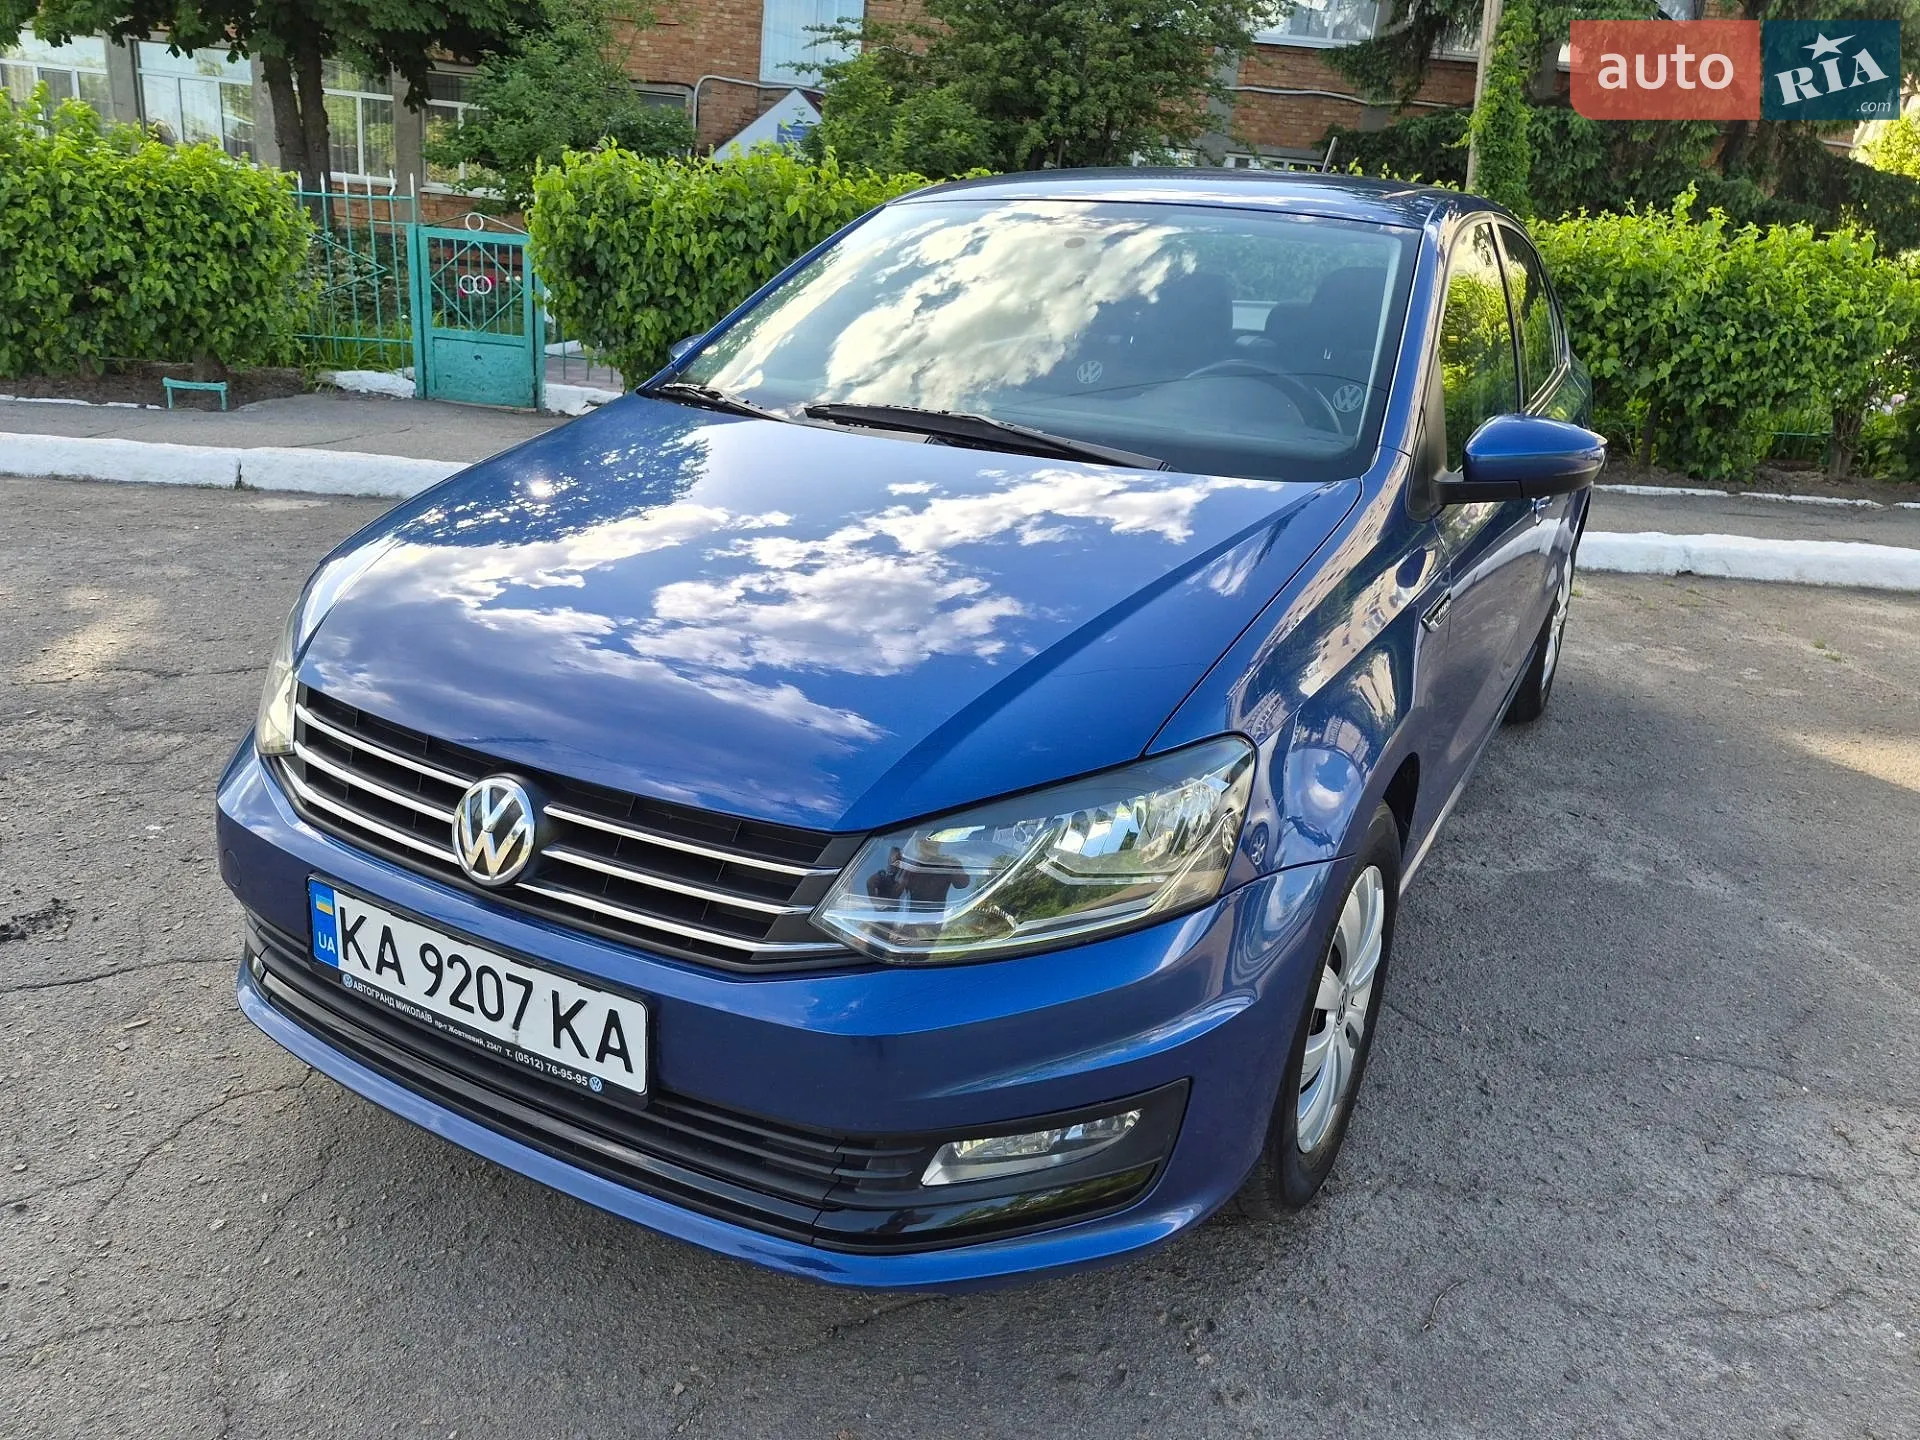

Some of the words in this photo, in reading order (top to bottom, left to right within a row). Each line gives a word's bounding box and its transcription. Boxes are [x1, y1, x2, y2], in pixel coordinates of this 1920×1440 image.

[318, 931, 336, 954] UA
[340, 906, 406, 986] KA
[419, 943, 534, 1031] 9207
[550, 990, 634, 1074] KA
[353, 981, 395, 1008] АВТОГРАНД
[395, 1000, 433, 1023] МИКОЛАЇВ
[514, 1050, 544, 1071] (0512)
[545, 1063, 588, 1086] 76-95-95
